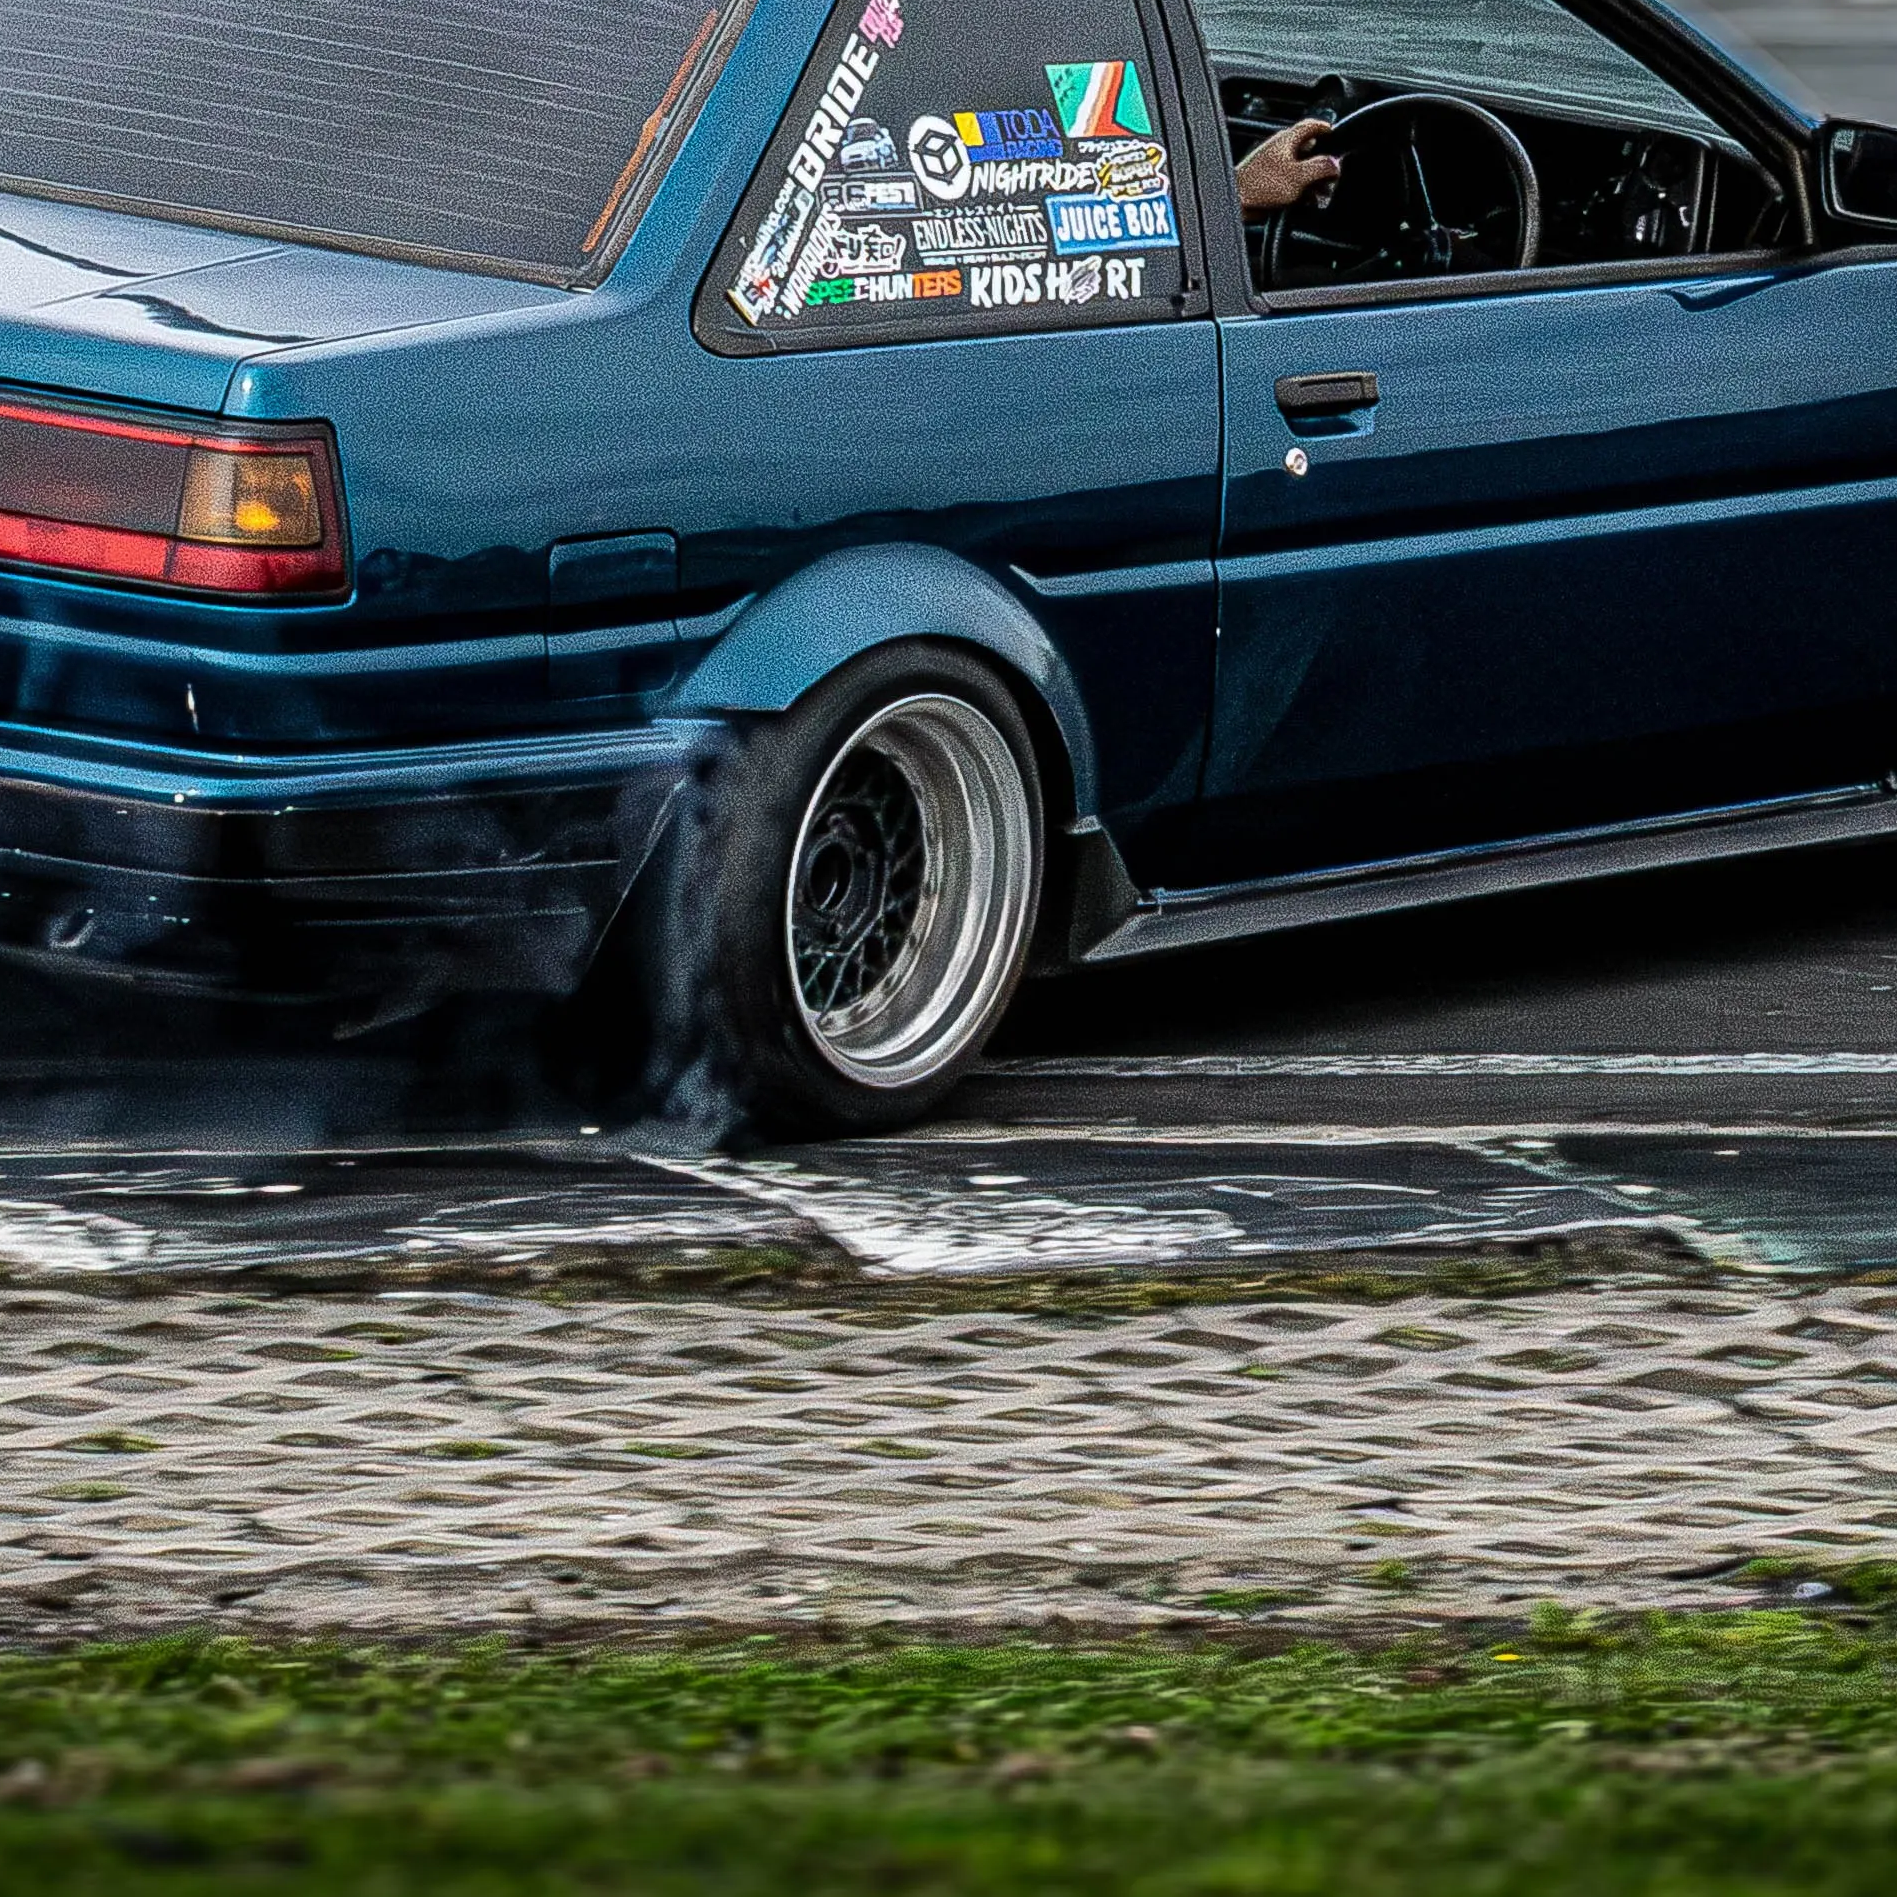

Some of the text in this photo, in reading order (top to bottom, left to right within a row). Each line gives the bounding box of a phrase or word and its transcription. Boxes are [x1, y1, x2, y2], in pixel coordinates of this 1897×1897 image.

[788, 33, 879, 192] BRIDE
[997, 108, 1060, 139] TODA
[1057, 201, 1170, 241] JUICE BOX
[970, 263, 1042, 309] KIDS
